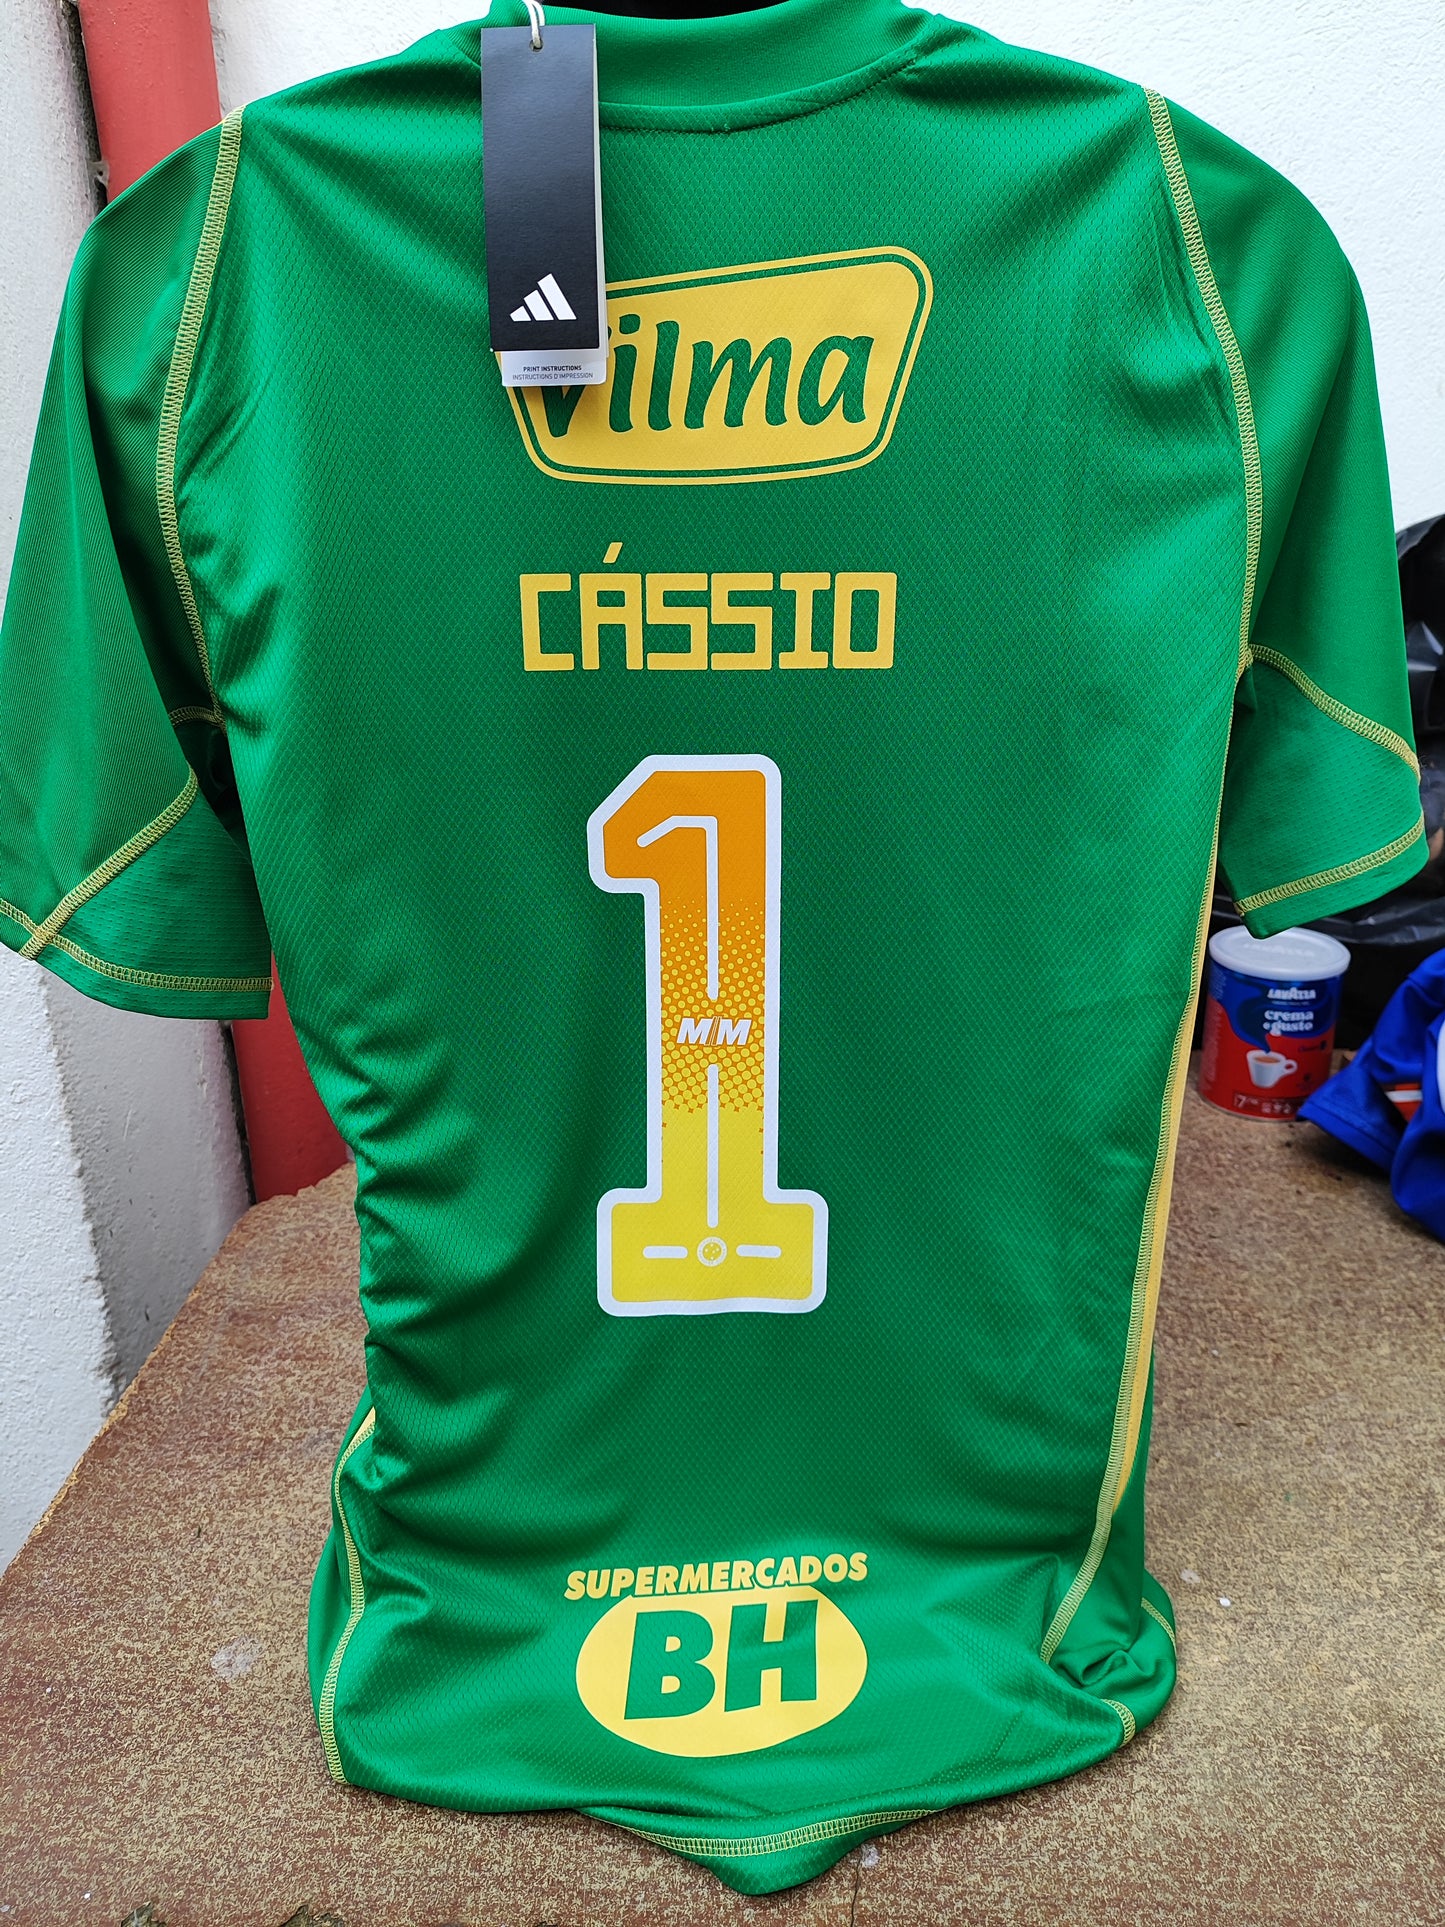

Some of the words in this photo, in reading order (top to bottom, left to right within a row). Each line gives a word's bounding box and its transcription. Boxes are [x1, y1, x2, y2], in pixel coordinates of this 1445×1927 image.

[519, 541, 897, 671] CÁSSIO
[587, 754, 829, 1316] 1
[1264, 1009, 1314, 1021] crema
[1270, 1021, 1313, 1037] gusto
[563, 1552, 868, 1601] SUPERMERCADOS
[624, 1599, 819, 1720] BH
